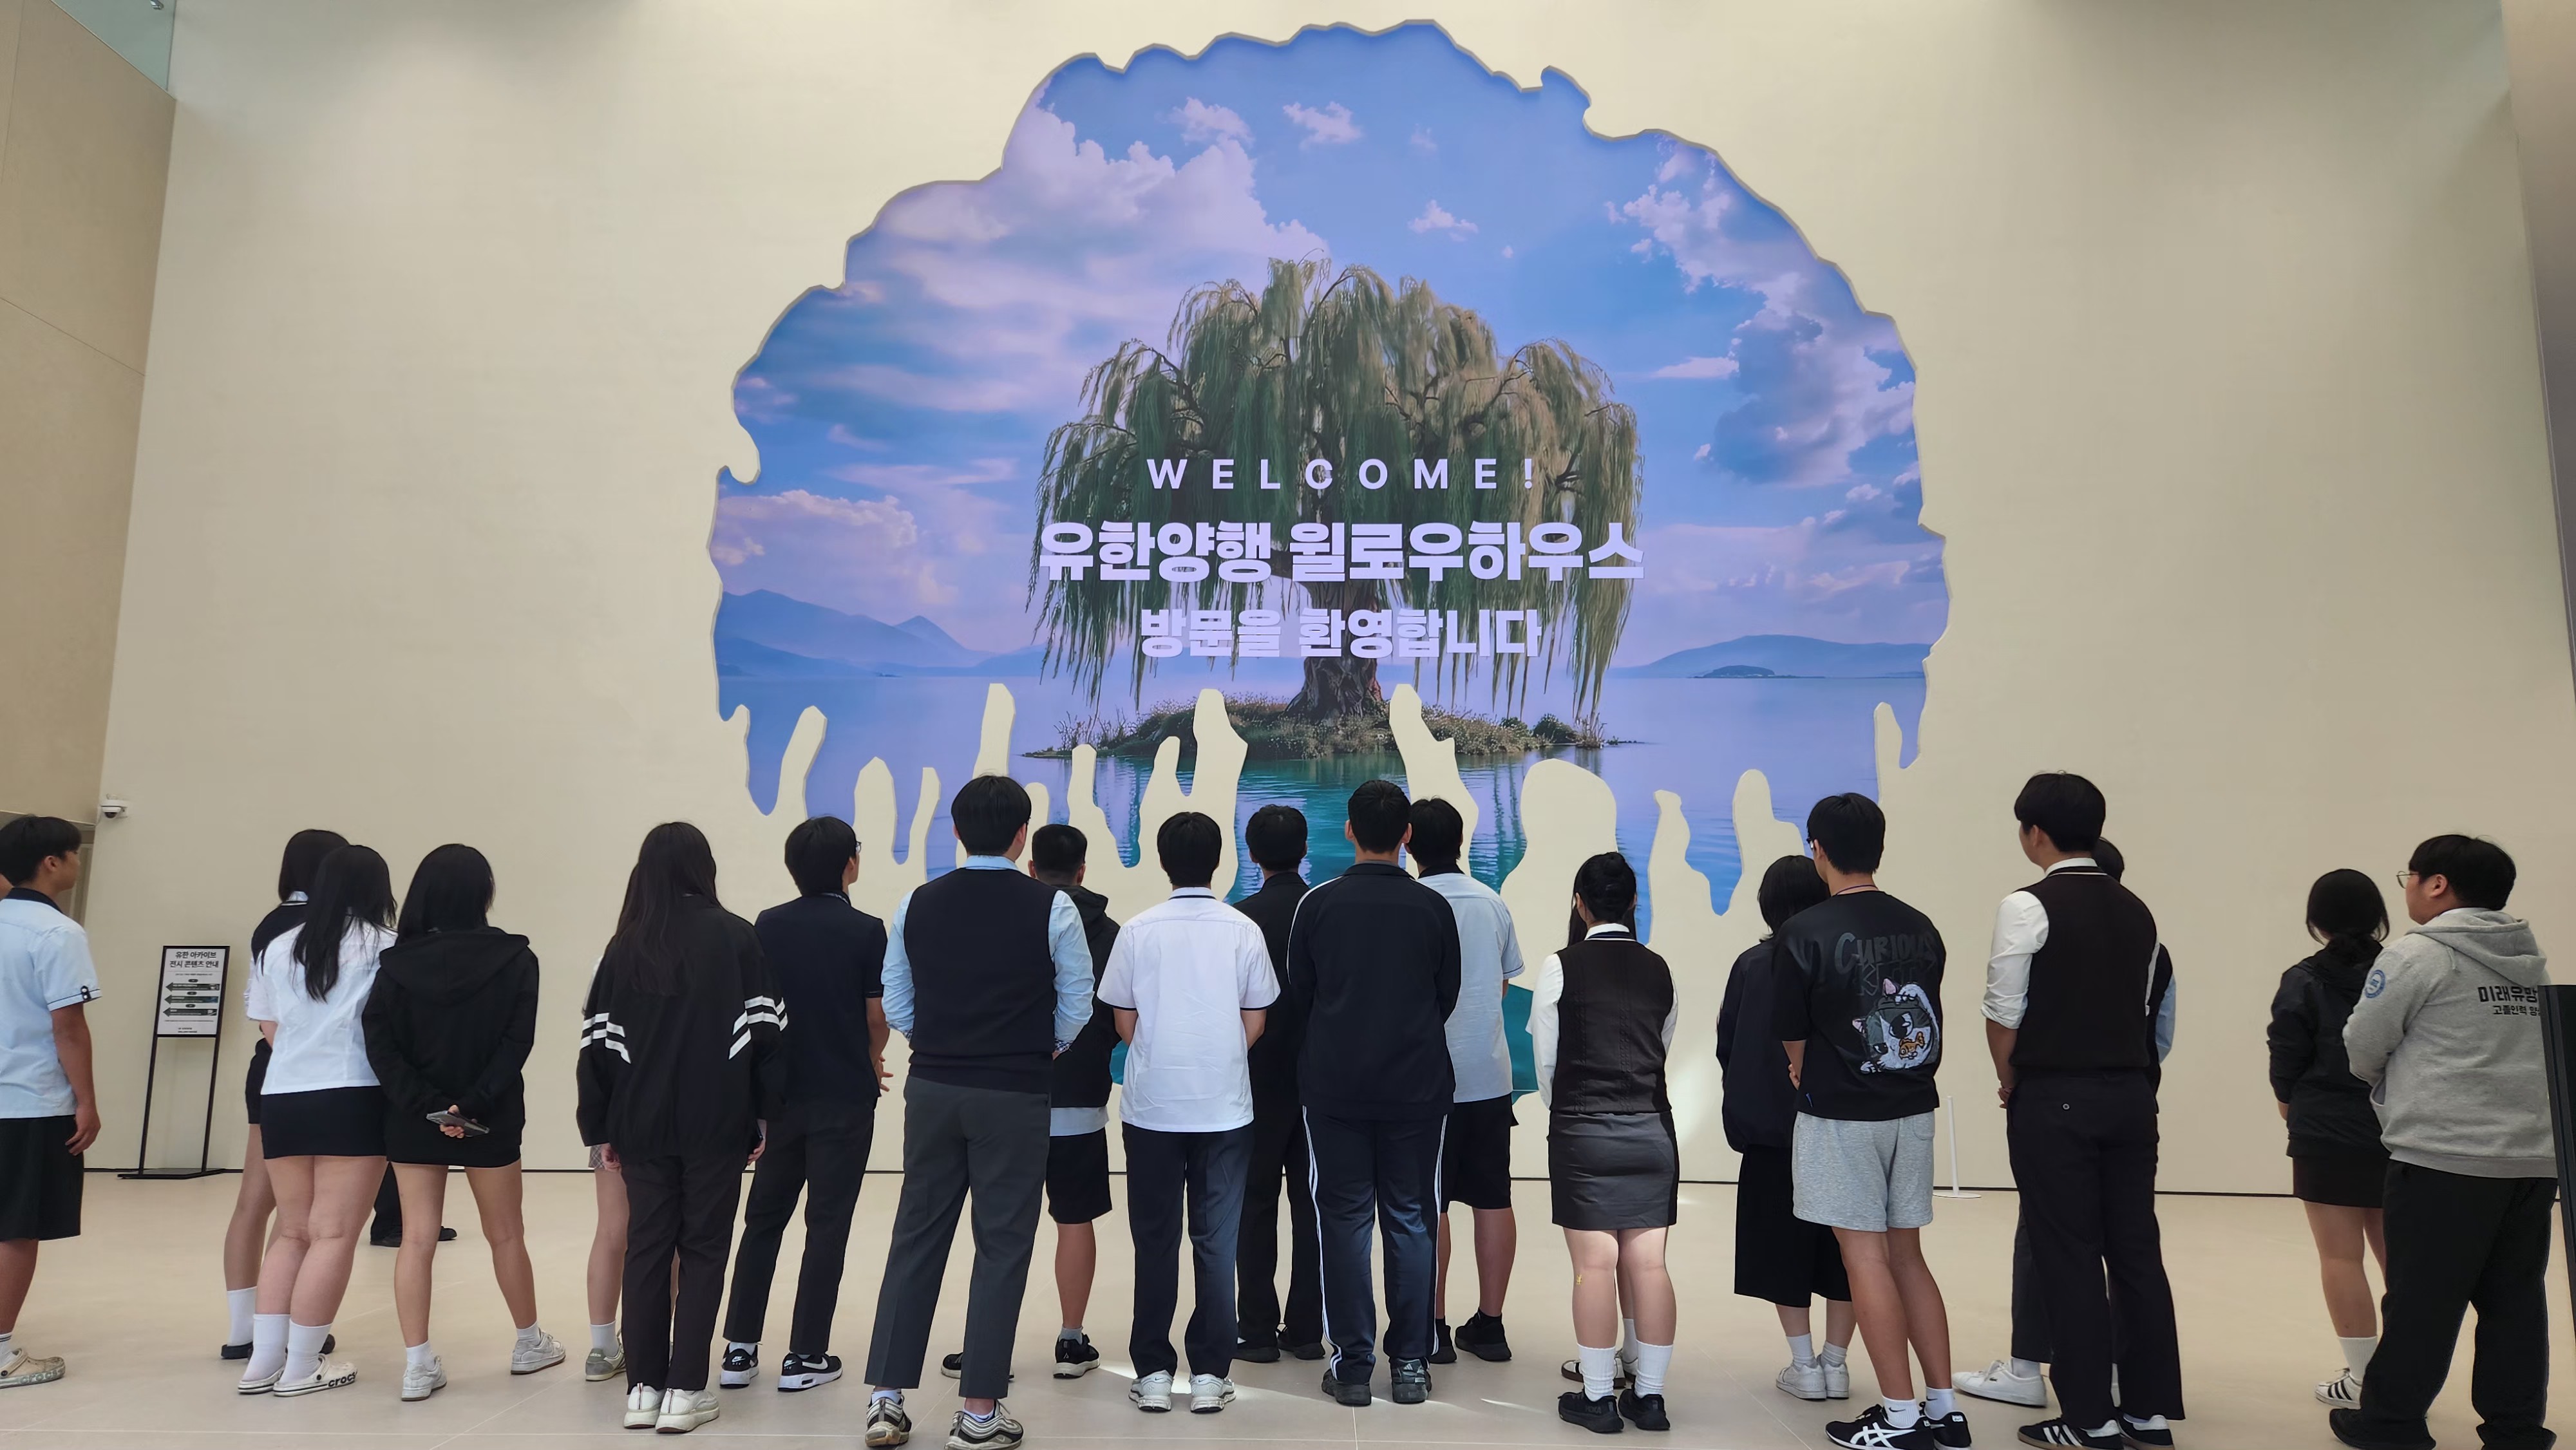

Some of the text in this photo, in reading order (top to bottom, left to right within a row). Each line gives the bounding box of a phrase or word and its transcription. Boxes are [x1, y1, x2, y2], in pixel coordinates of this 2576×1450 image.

[1146, 458, 1533, 490] WELCOME!
[1039, 520, 1645, 583] 유한양행 윌로우하우스
[1141, 608, 1542, 658] 방문을 환영합니다
[169, 960, 219, 968] 전시 콘텐츠 안내
[328, 1371, 356, 1387] crocs
